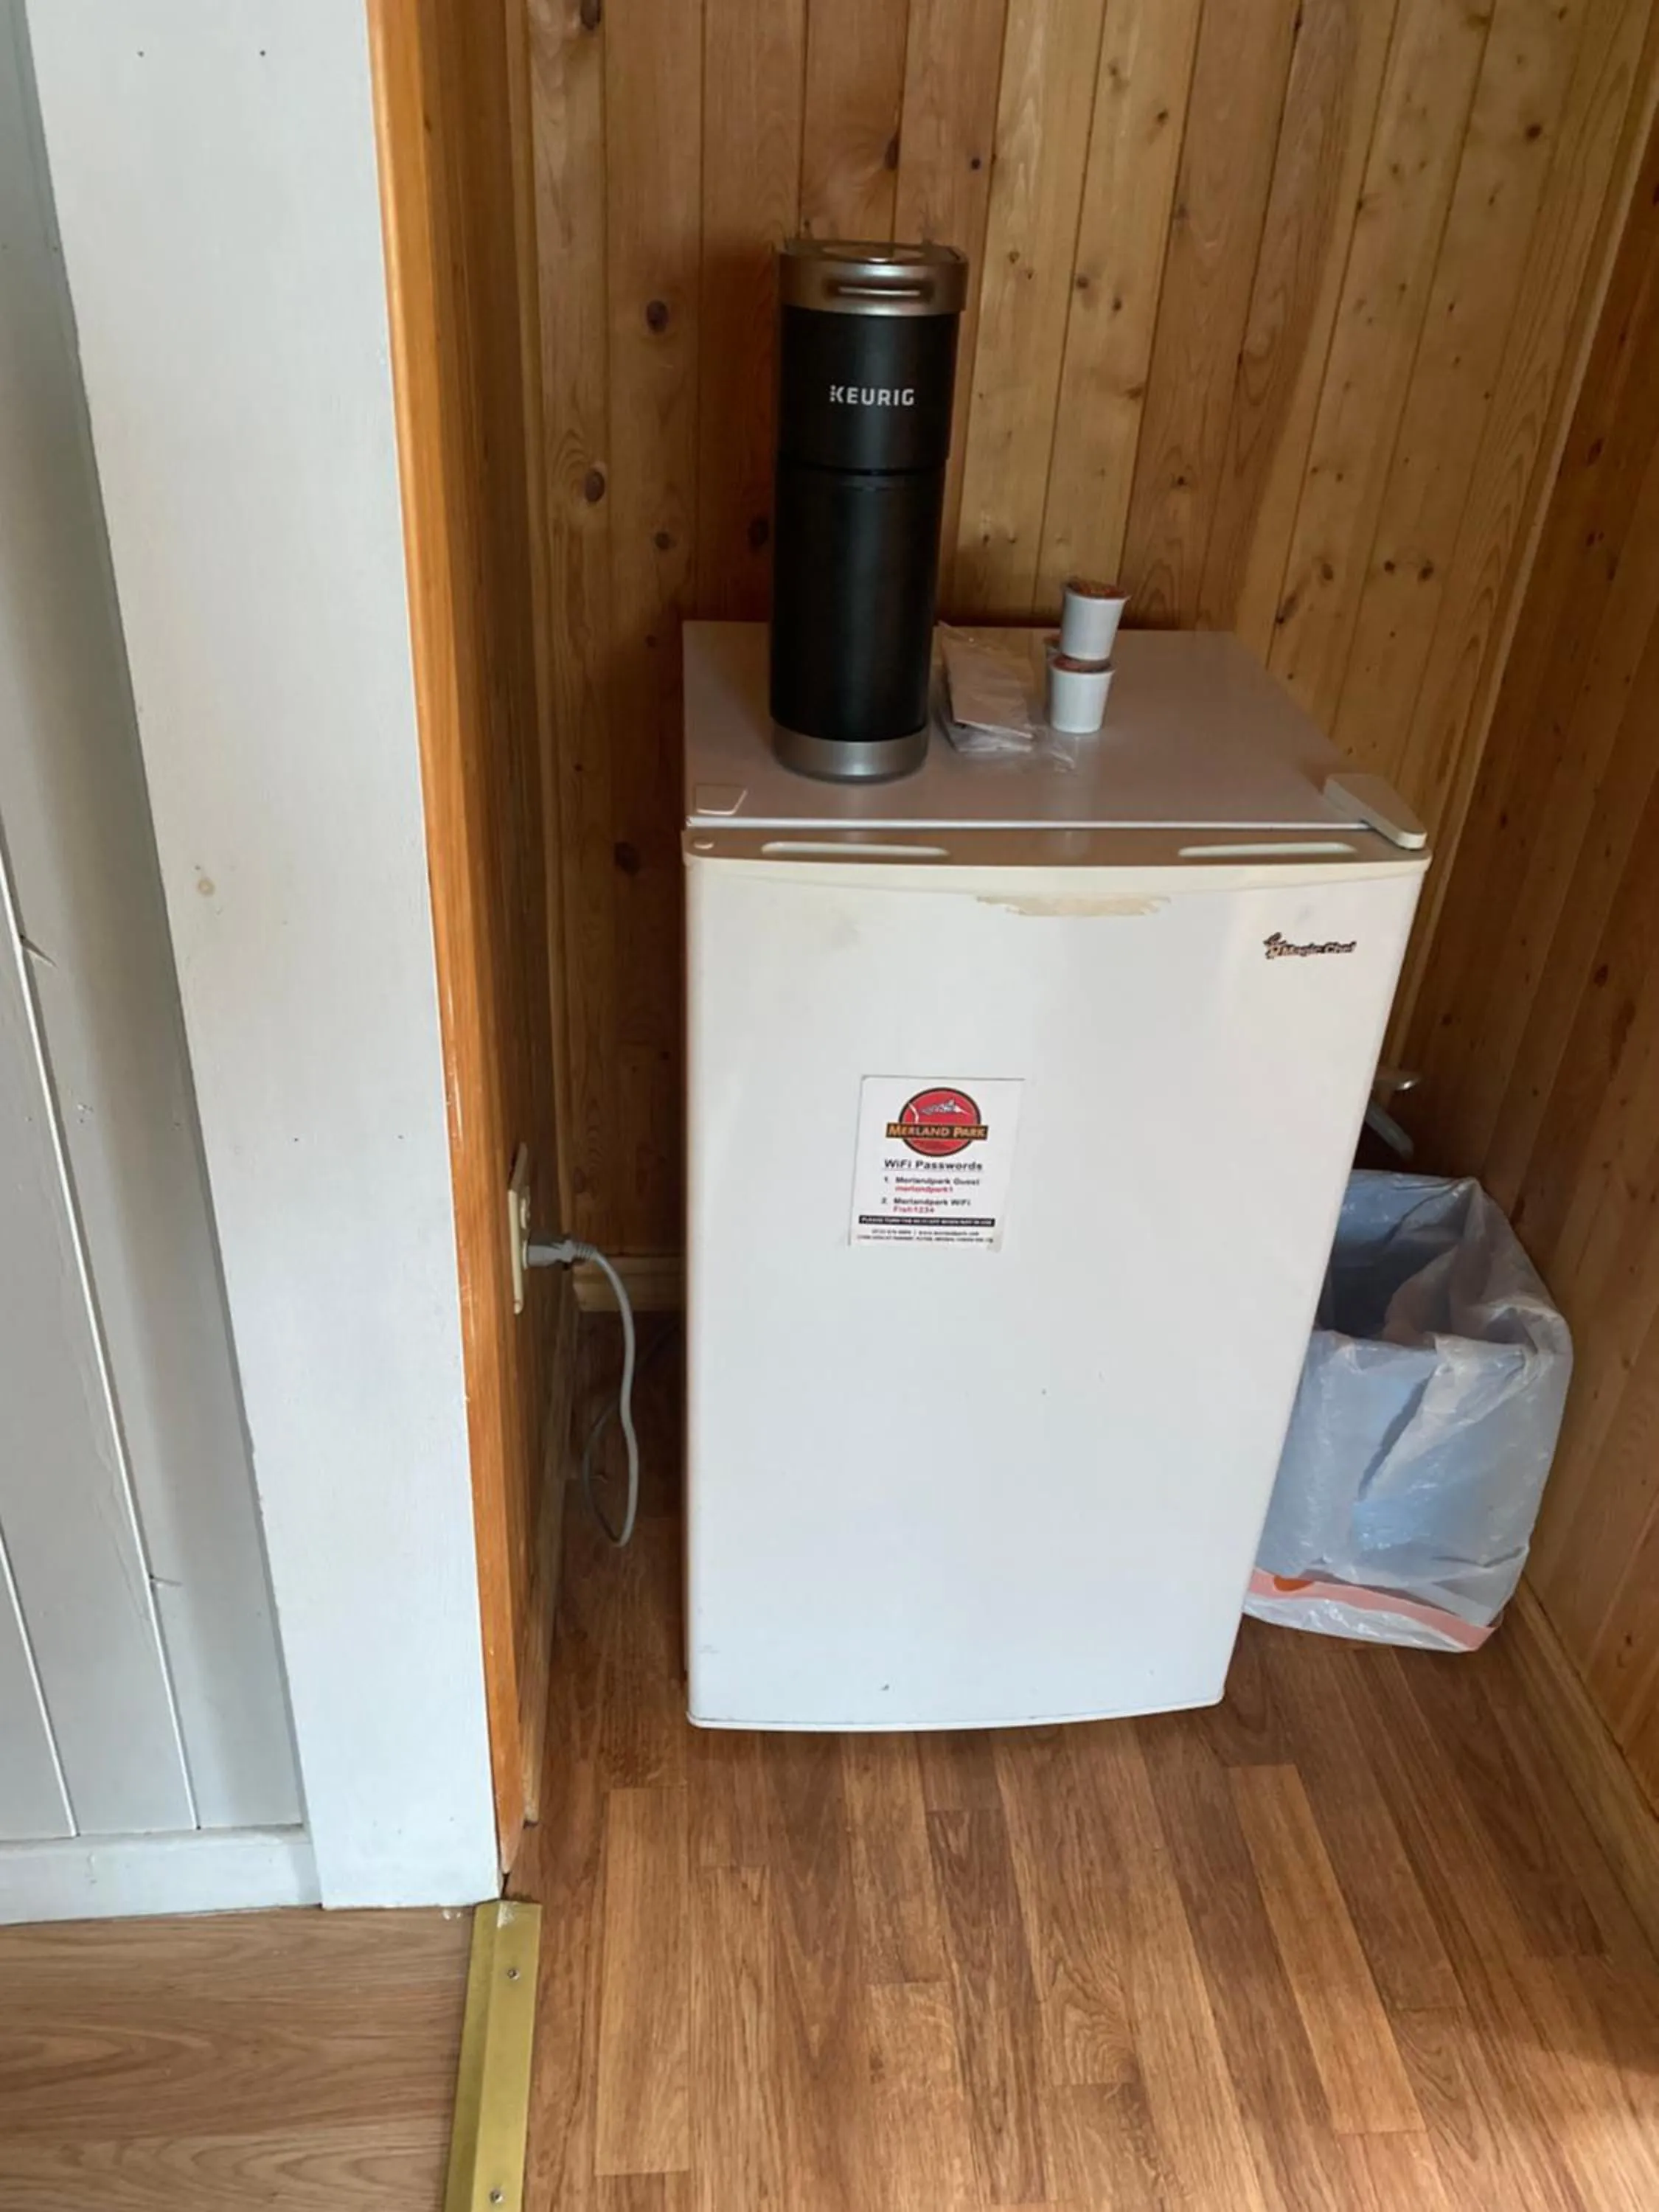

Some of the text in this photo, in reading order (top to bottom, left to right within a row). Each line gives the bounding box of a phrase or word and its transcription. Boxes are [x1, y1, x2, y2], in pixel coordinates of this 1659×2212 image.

[830, 384, 915, 406] KEURIG
[953, 1127, 986, 1138] PARK
[884, 1159, 983, 1171] WiFi Passwords
